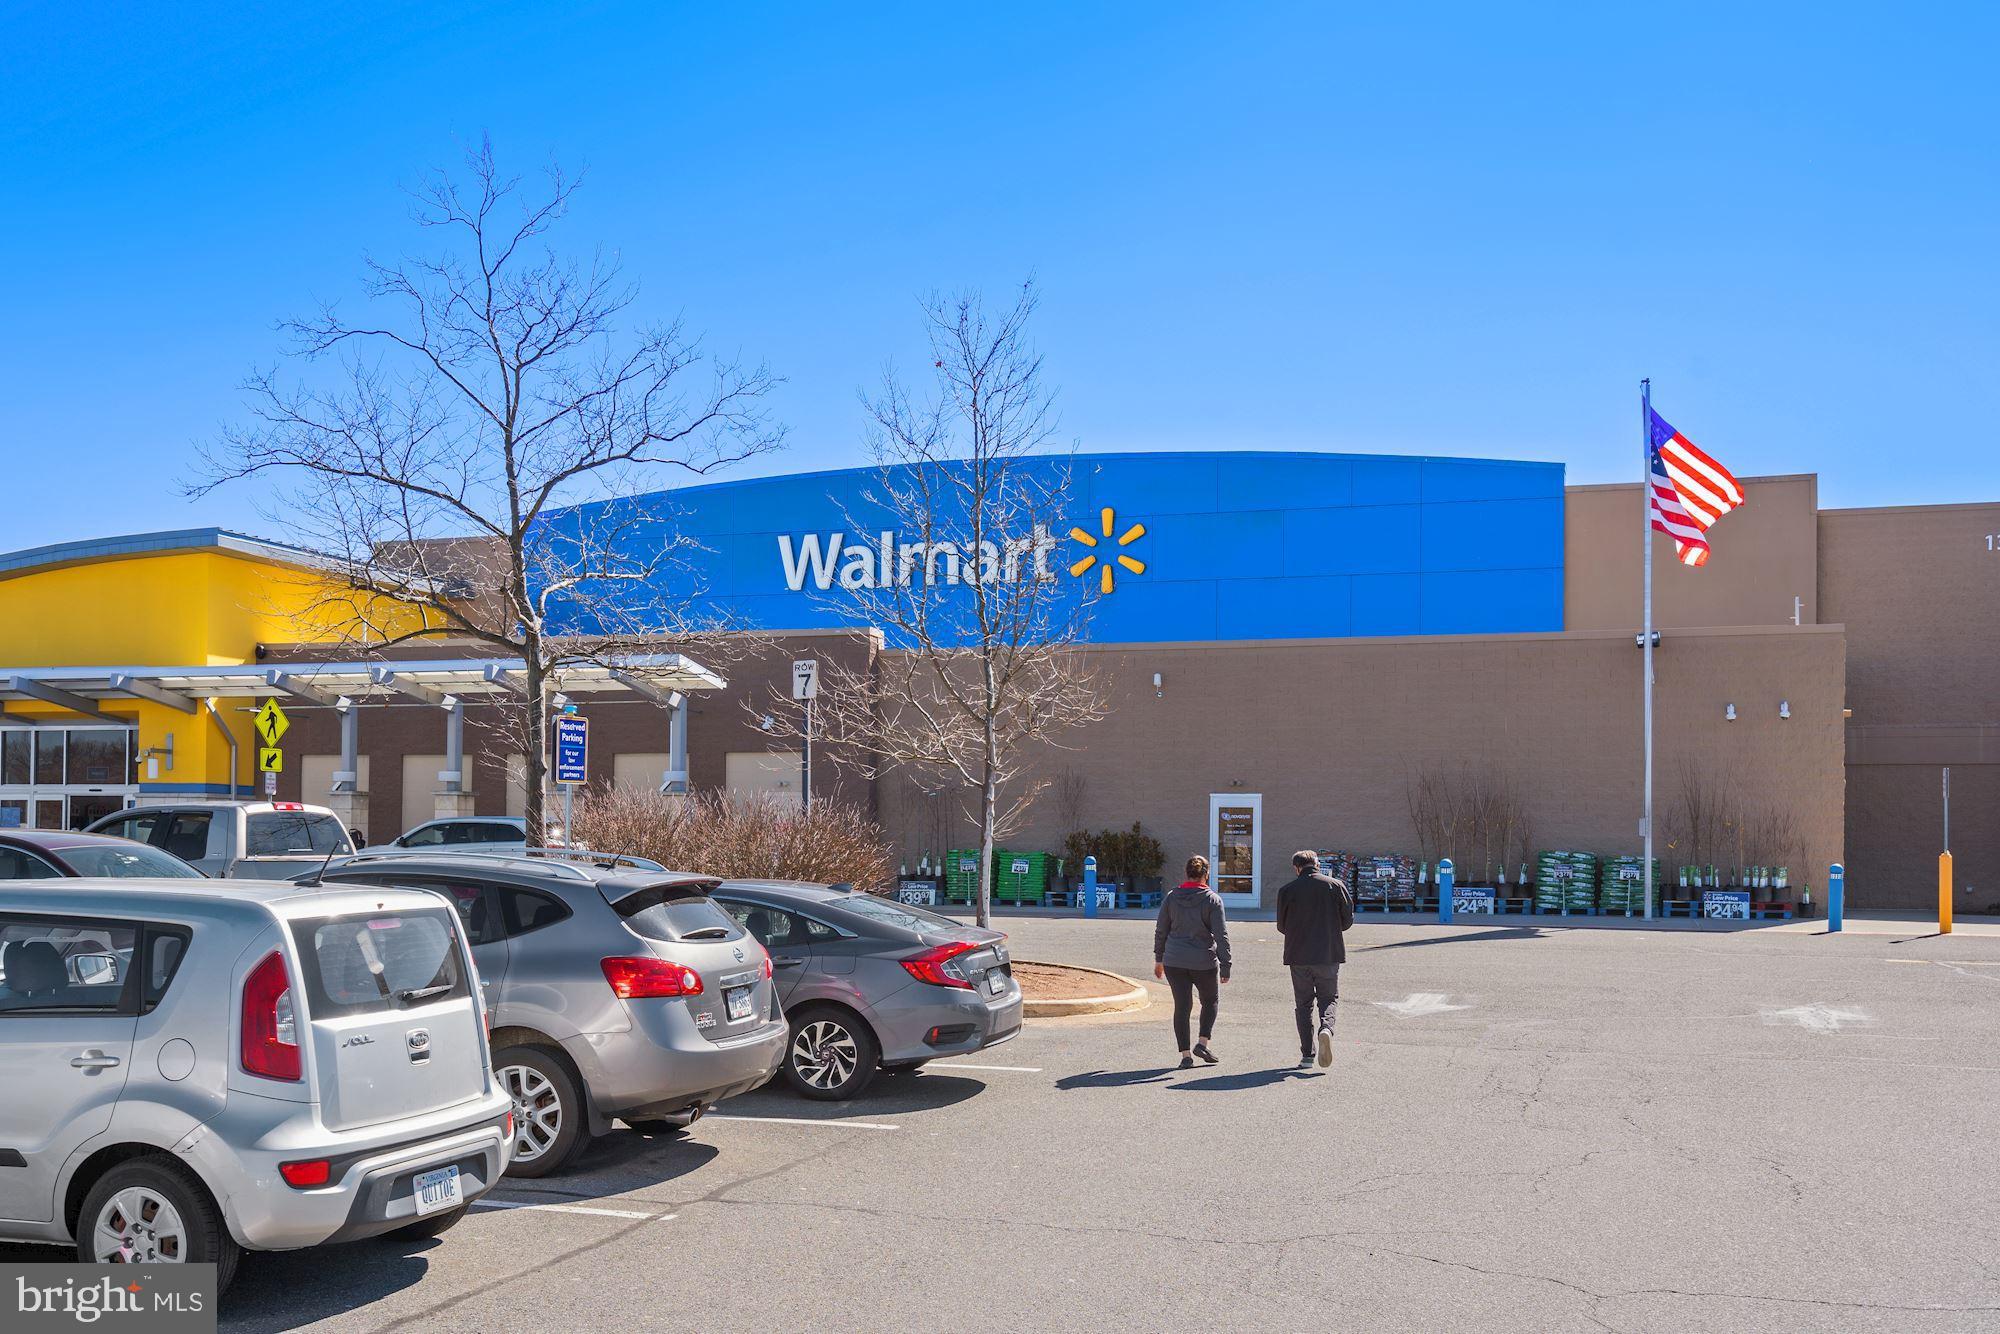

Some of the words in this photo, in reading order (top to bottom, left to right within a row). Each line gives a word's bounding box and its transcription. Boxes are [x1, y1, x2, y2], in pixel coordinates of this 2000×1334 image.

[777, 524, 1056, 591] Walmart
[794, 663, 815, 671] ROW
[798, 673, 811, 696] 7
[560, 721, 585, 731] Reserved
[562, 733, 583, 744] Parking
